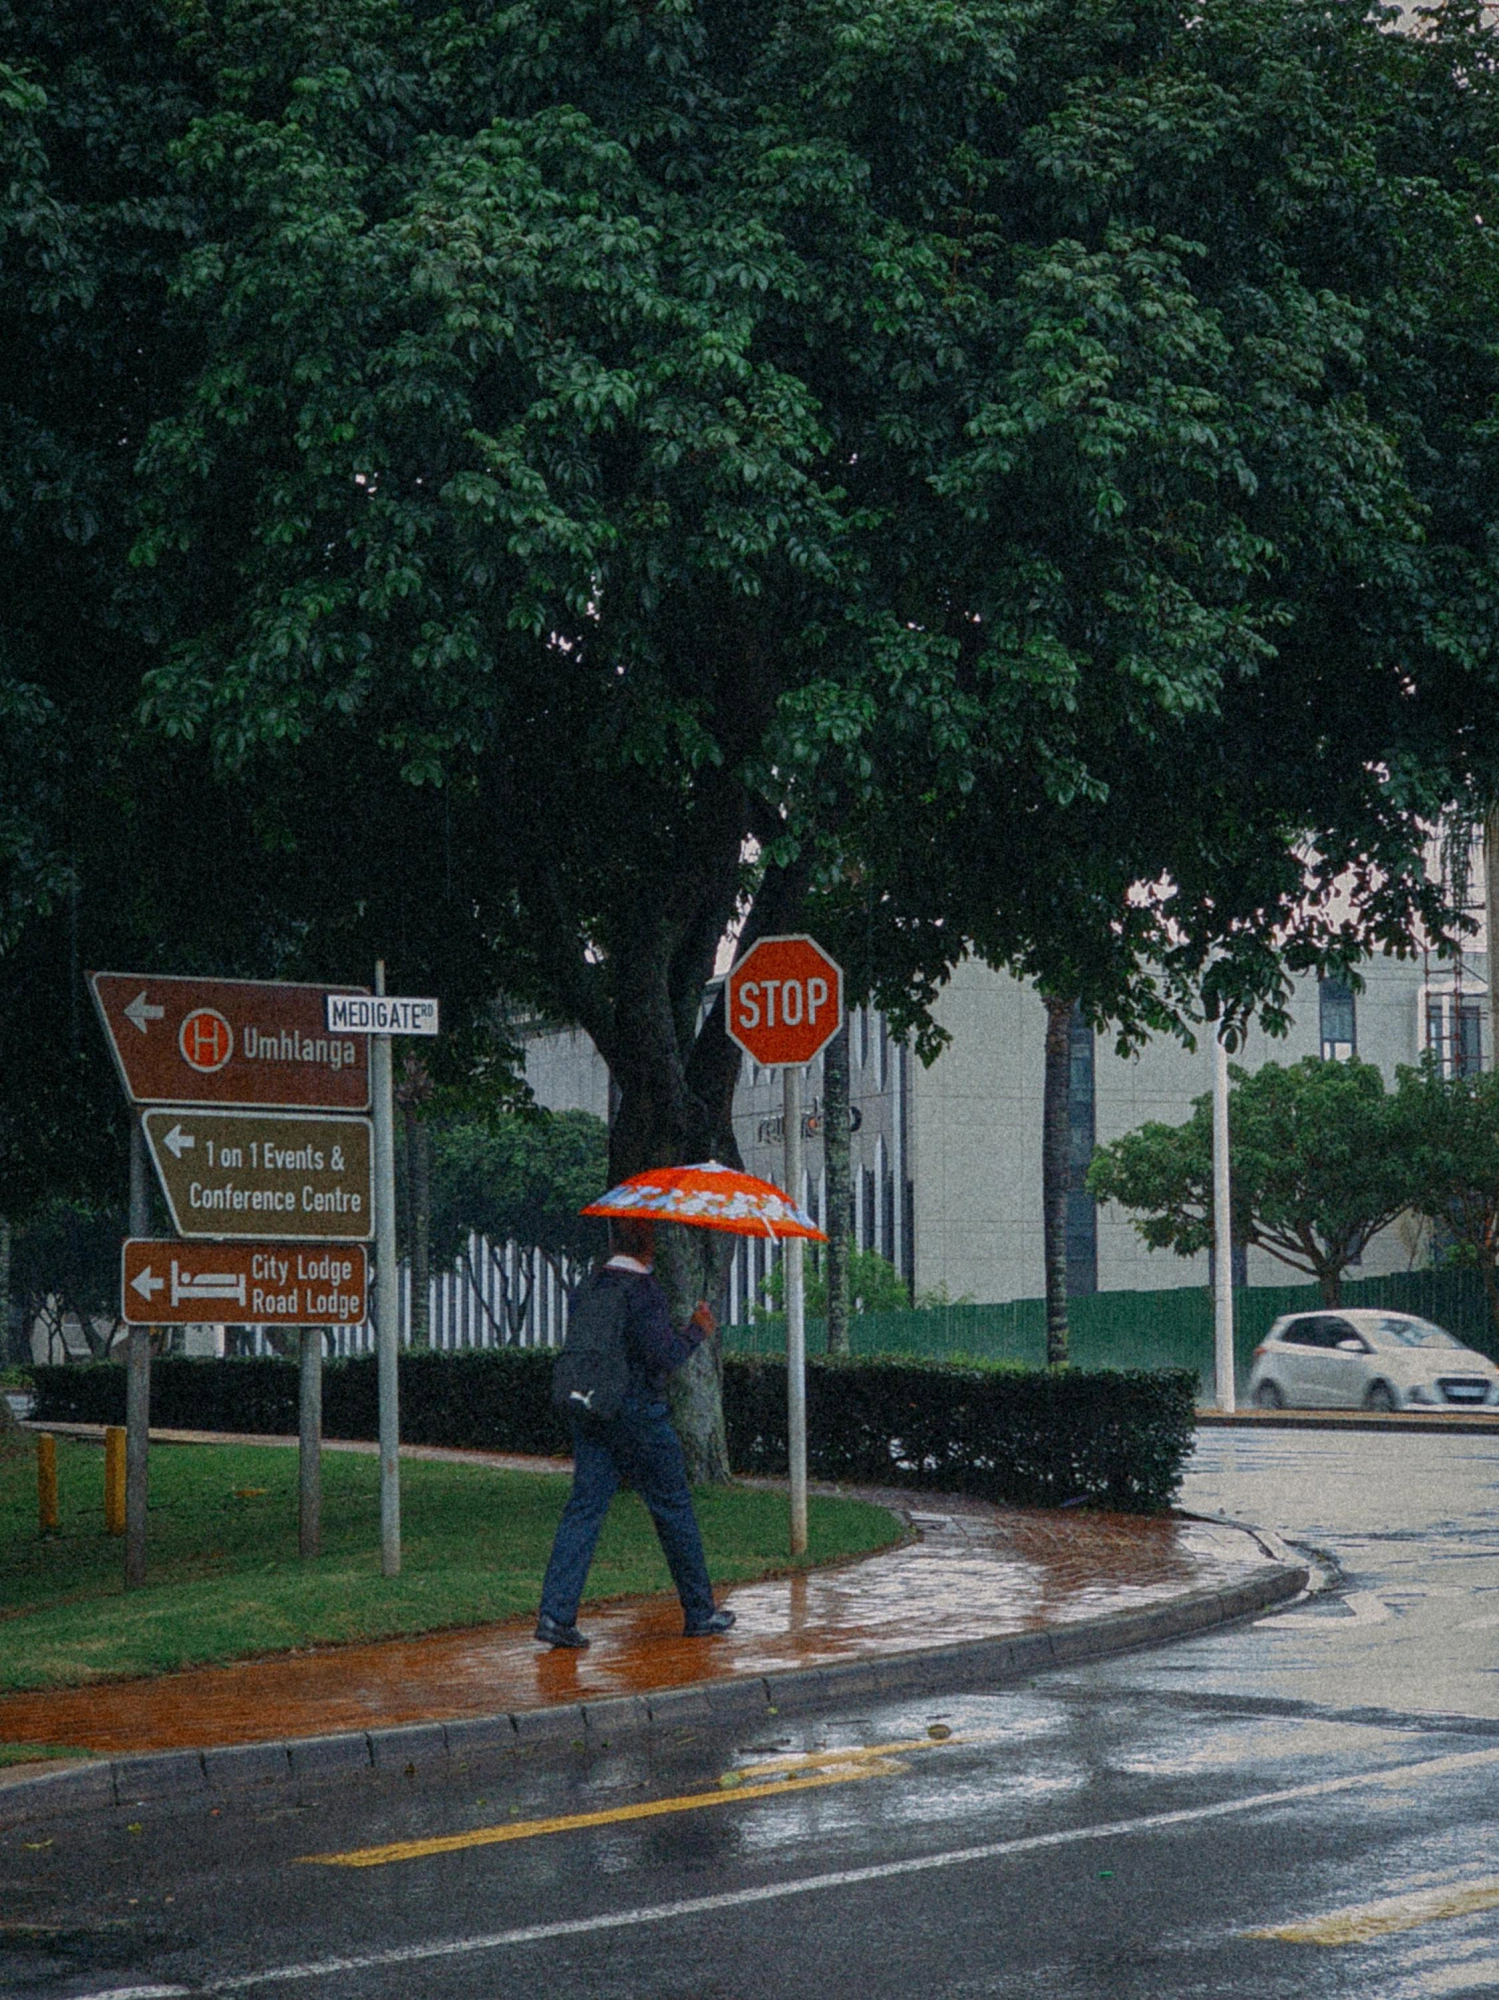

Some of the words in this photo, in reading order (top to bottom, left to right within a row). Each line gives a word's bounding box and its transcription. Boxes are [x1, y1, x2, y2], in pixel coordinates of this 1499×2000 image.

[332, 1000, 422, 1029] MEDIGATE
[421, 1004, 434, 1017] RD
[738, 976, 829, 1029] STOP
[193, 1020, 220, 1061] H
[243, 1028, 355, 1070] Umhlanga
[205, 1140, 215, 1168] 1
[221, 1147, 242, 1168] on
[250, 1141, 259, 1168] 1
[264, 1143, 324, 1171] Events
[331, 1146, 345, 1171] &
[189, 1182, 296, 1211] Conference
[302, 1185, 361, 1213] Centre
[252, 1253, 289, 1285] City
[297, 1255, 353, 1285] Lodge
[252, 1290, 298, 1314] Road
[306, 1291, 360, 1320] Lodge
